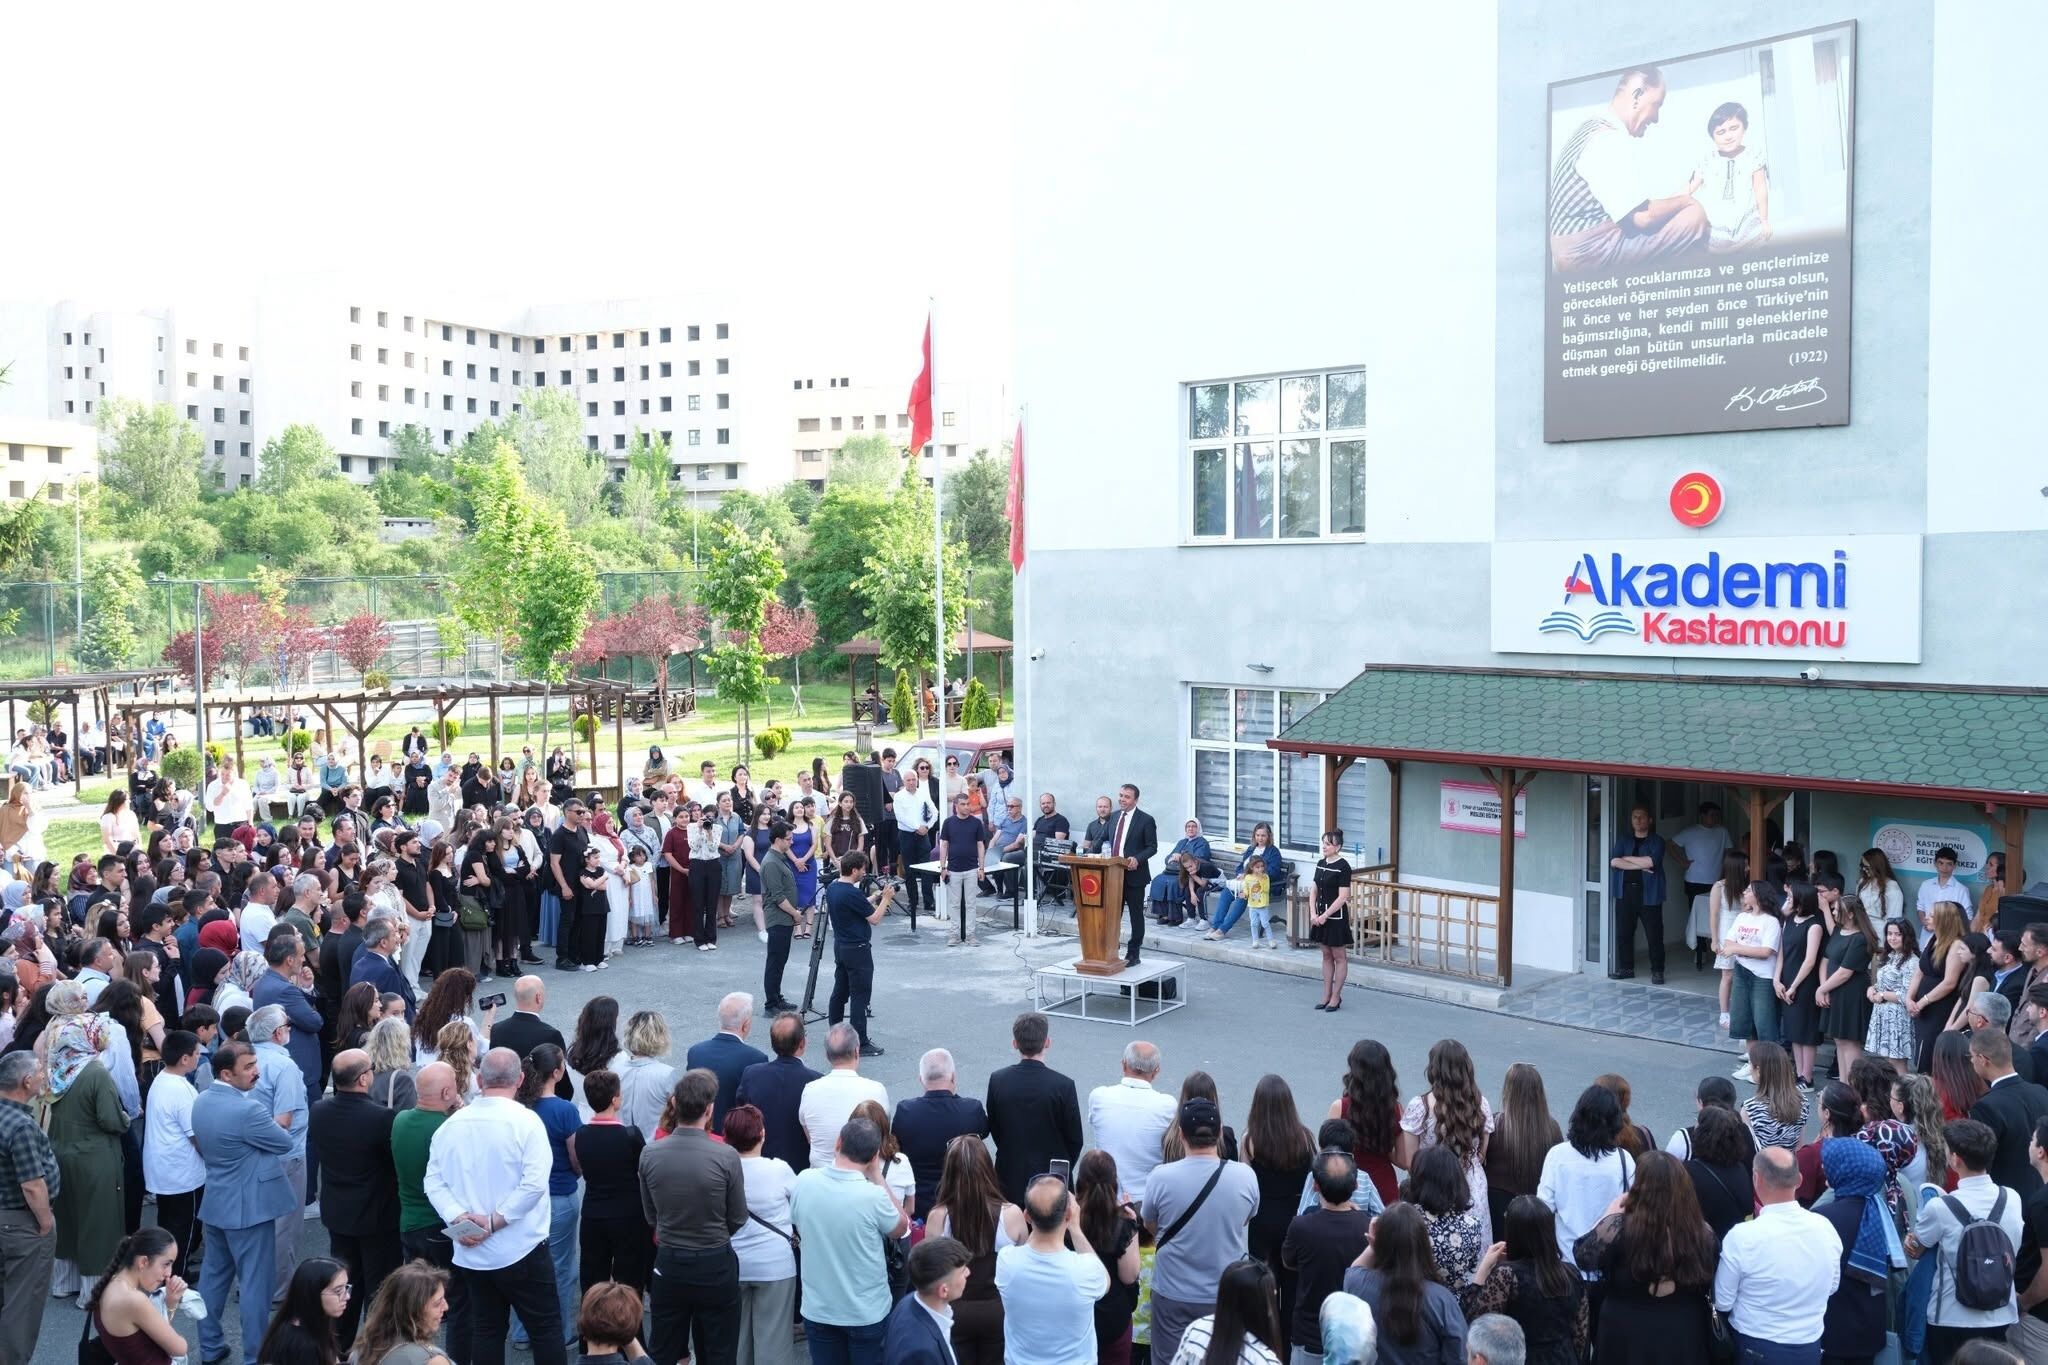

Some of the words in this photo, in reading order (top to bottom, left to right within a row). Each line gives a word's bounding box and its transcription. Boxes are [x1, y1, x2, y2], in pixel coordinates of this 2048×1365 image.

[1564, 277, 1618, 294] Yetişecek
[1626, 268, 1710, 288] çocuklarımıza
[1720, 266, 1734, 275] ve
[1742, 252, 1829, 274] gençlerimize
[1563, 293, 1626, 312] görecekleri
[1630, 286, 1690, 304] öğrenimin
[1694, 284, 1723, 296] sınırı
[1728, 282, 1742, 292] ne
[1746, 277, 1785, 290] olursa
[1789, 271, 1829, 287] olsun,
[1563, 316, 1576, 328] ilk
[1584, 314, 1610, 325] önce
[1618, 312, 1631, 321] ve
[1639, 308, 1658, 320] her
[1666, 303, 1708, 318] şeyden
[1717, 300, 1747, 311] önce
[1756, 289, 1828, 306] Türkiye’nin
[1562, 349, 1607, 361] düşman
[1615, 344, 1640, 356] olan
[1648, 340, 1683, 353] bütün
[1692, 333, 1754, 349] unsurlarla
[1763, 326, 1828, 342] mücadele
[1563, 327, 1651, 344] bağımsızlığına,
[1659, 320, 1692, 334] kendi
[1701, 317, 1728, 330] milli
[1736, 308, 1828, 329] geleneklerine
[1562, 364, 1598, 378] etmek
[1600, 360, 1637, 376] gereği
[1640, 353, 1726, 372] öğretilmelidir.
[1788, 350, 1828, 366] (1922)
[1565, 550, 1847, 608] Akademi
[1643, 612, 1846, 647] Kastamonu
[1916, 840, 1966, 851] KASTAMONU
